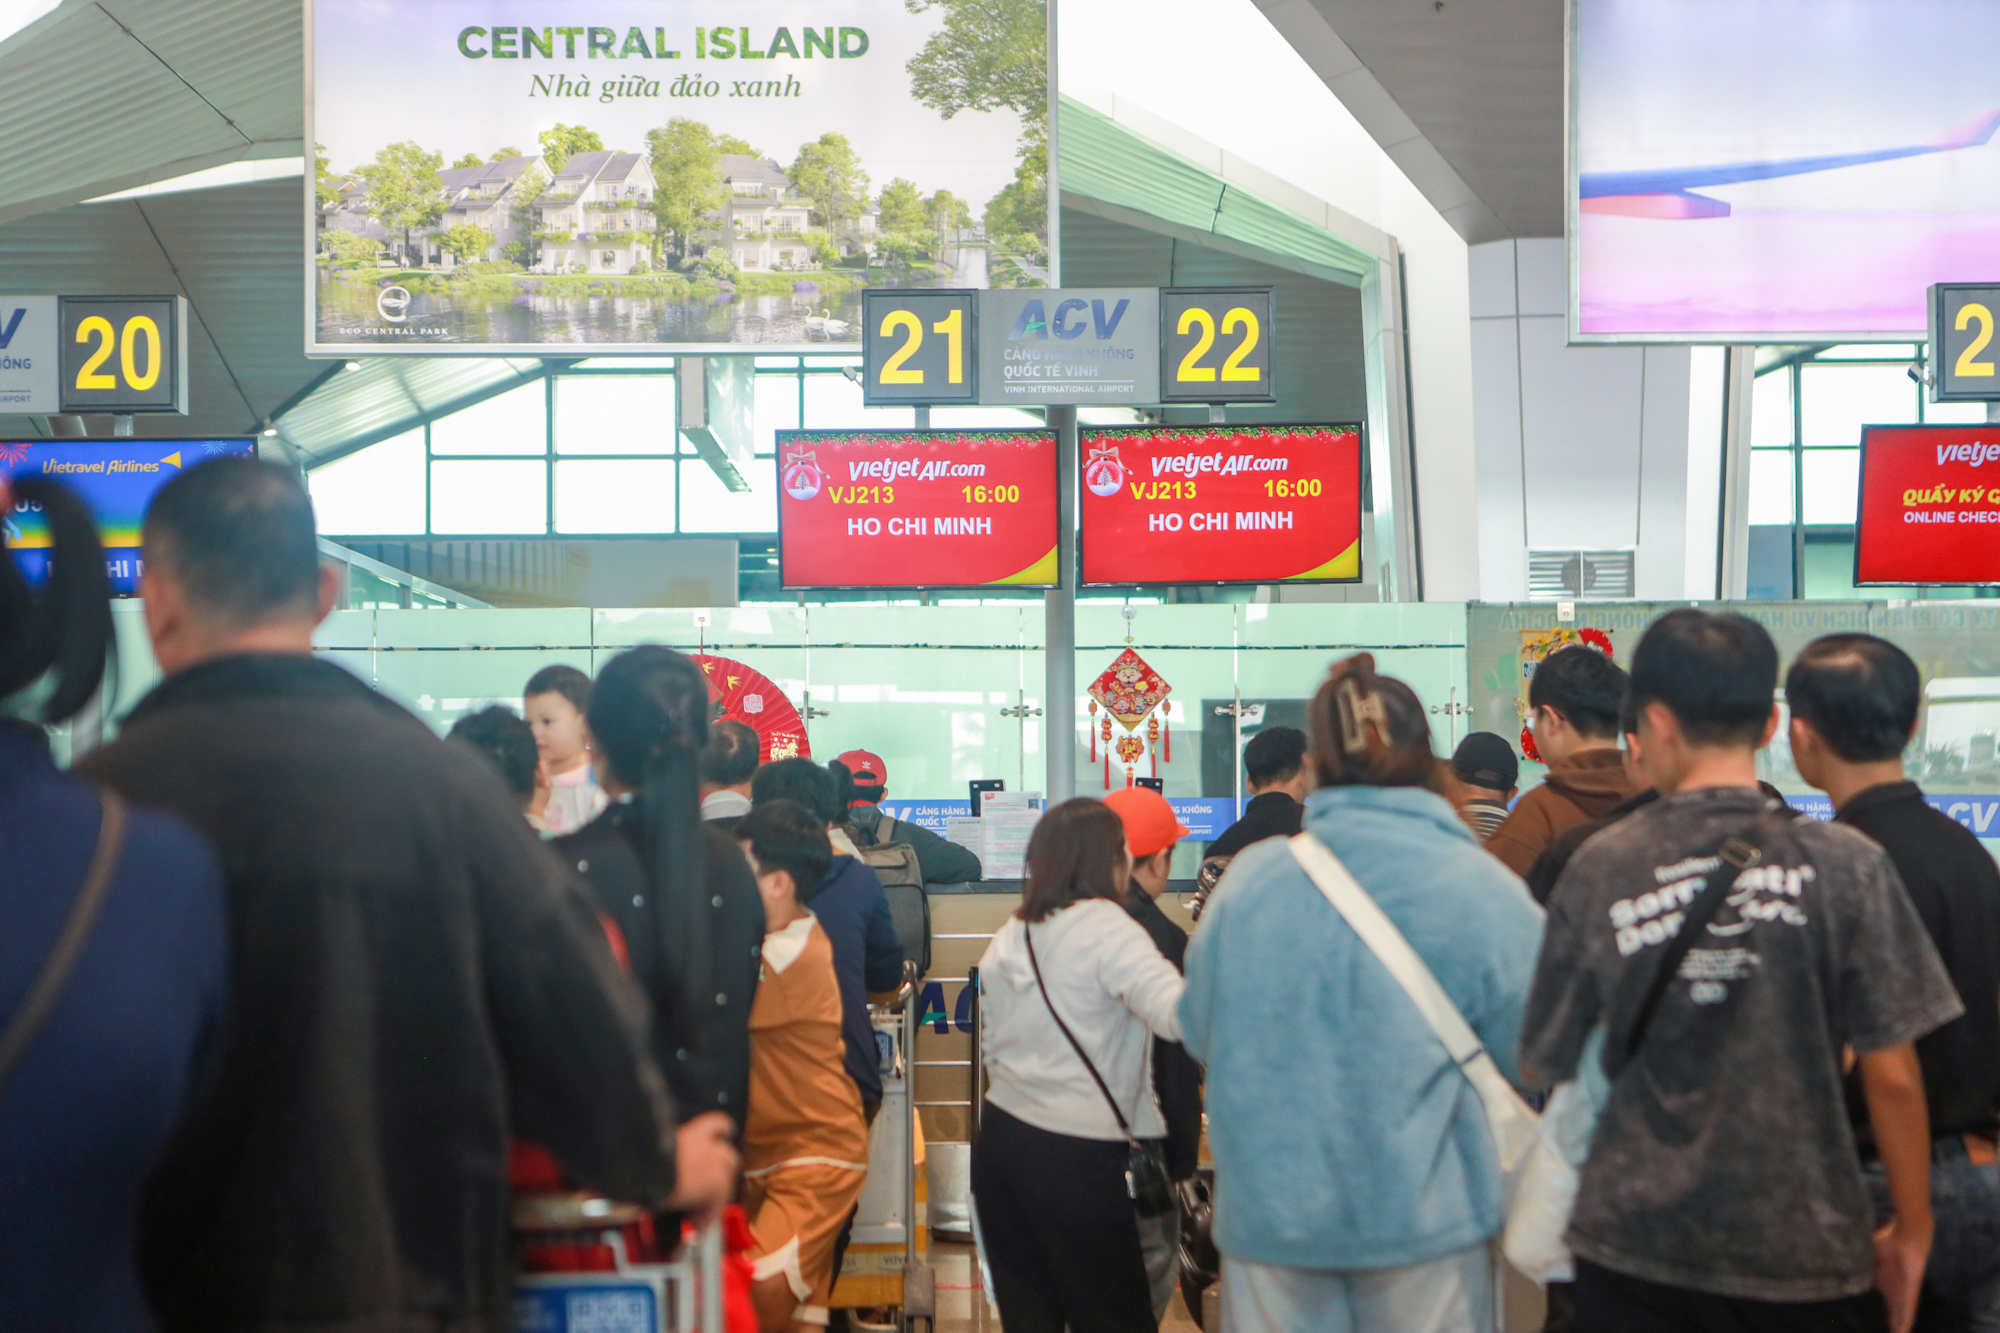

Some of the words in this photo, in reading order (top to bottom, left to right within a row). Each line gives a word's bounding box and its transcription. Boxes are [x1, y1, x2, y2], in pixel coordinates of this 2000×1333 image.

[456, 25, 681, 60] CENTRAL
[695, 26, 870, 59] ISLAND
[528, 73, 591, 98] Nhà
[598, 74, 660, 104] giữa
[669, 73, 720, 98] đảo
[729, 74, 801, 98] xanh
[1007, 298, 1131, 341] ACV
[340, 327, 361, 335] ECO
[365, 327, 415, 335] CENTRAL
[420, 327, 448, 335] PARK
[1954, 302, 2000, 377] 2
[75, 315, 161, 390] 20
[879, 309, 962, 384] 21
[1003, 346, 1041, 360] CẢNG
[1087, 346, 1135, 360] KHÔNG
[1176, 307, 1260, 382] 22
[0, 355, 31, 370] ÔNG
[1003, 361, 1041, 379] QUỐC
[1044, 361, 1061, 377] TẾ
[1065, 365, 1098, 377] VINH
[1004, 385, 1025, 393] VINH
[1027, 385, 1095, 393] INTERNATIONAL
[1098, 385, 1134, 393] AIRPORT
[42, 458, 105, 474] Vietravel
[107, 459, 160, 475] Airlines
[828, 486, 895, 504] VJ213
[961, 485, 1020, 503] 16:00
[1130, 481, 1197, 500] VJ213
[1263, 478, 1322, 498] 16:00
[1959, 485, 1985, 503] KÝ
[847, 518, 882, 536] HO
[888, 518, 927, 536] CHI
[934, 517, 992, 535] MINH
[1149, 513, 1183, 532] HO
[1189, 512, 1229, 531] CHI
[1235, 511, 1293, 530] MINH
[1904, 511, 1955, 523] ONLINE
[106, 559, 130, 578] HI
[916, 806, 939, 816] CẢNG
[942, 806, 965, 816] HÀNG
[1182, 804, 1212, 814] KHÔNG
[1807, 801, 1832, 812] HÀNG
